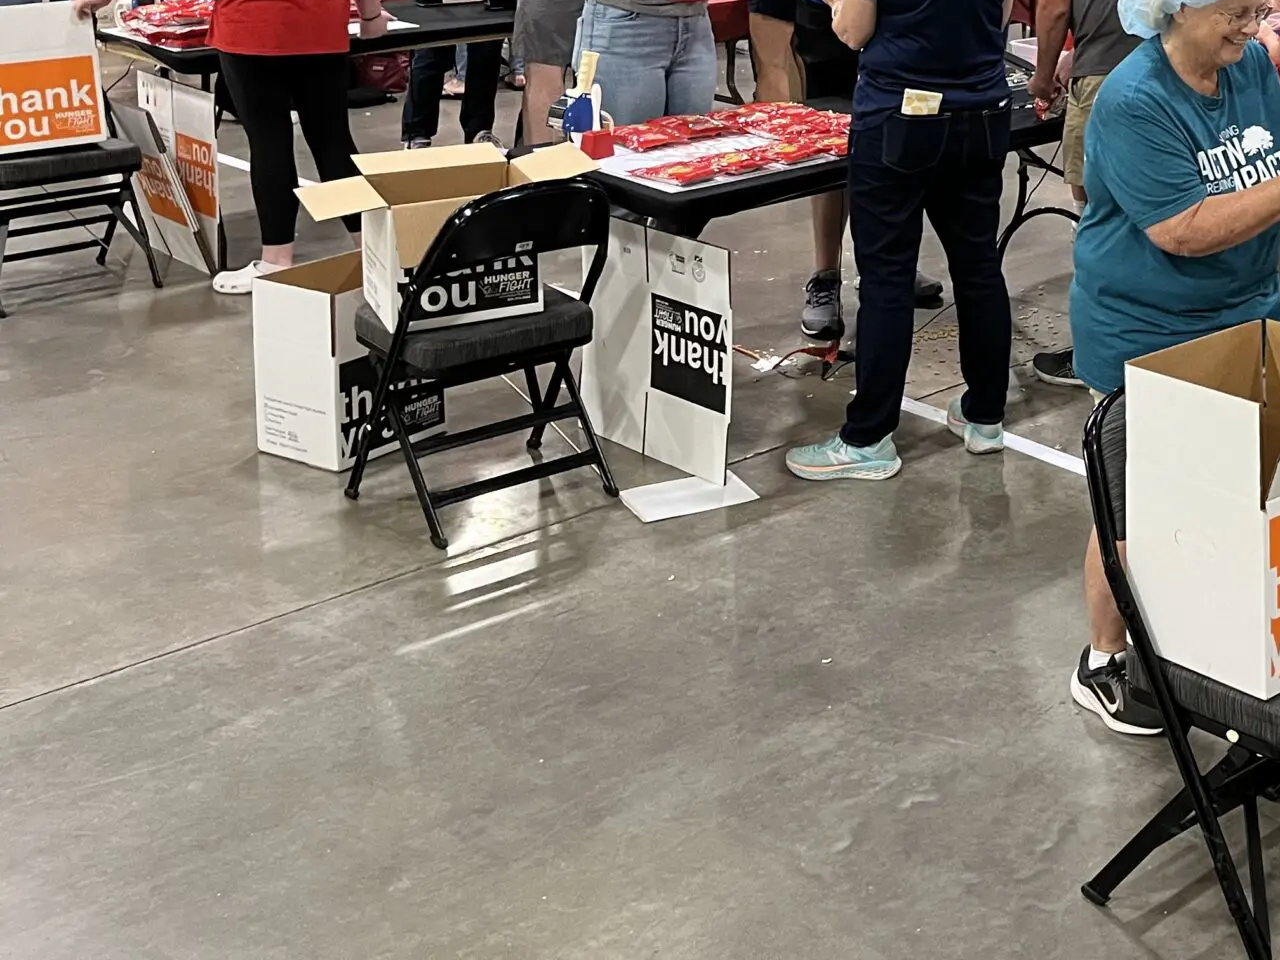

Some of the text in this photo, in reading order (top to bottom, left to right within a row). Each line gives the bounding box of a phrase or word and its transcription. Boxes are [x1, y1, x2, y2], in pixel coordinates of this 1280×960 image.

[0, 115, 51, 140] ou
[484, 271, 531, 284] HUNGER
[498, 277, 535, 293] FIGHT
[419, 280, 477, 312] ou
[654, 328, 728, 386] thank
[404, 395, 438, 413] HUNGER
